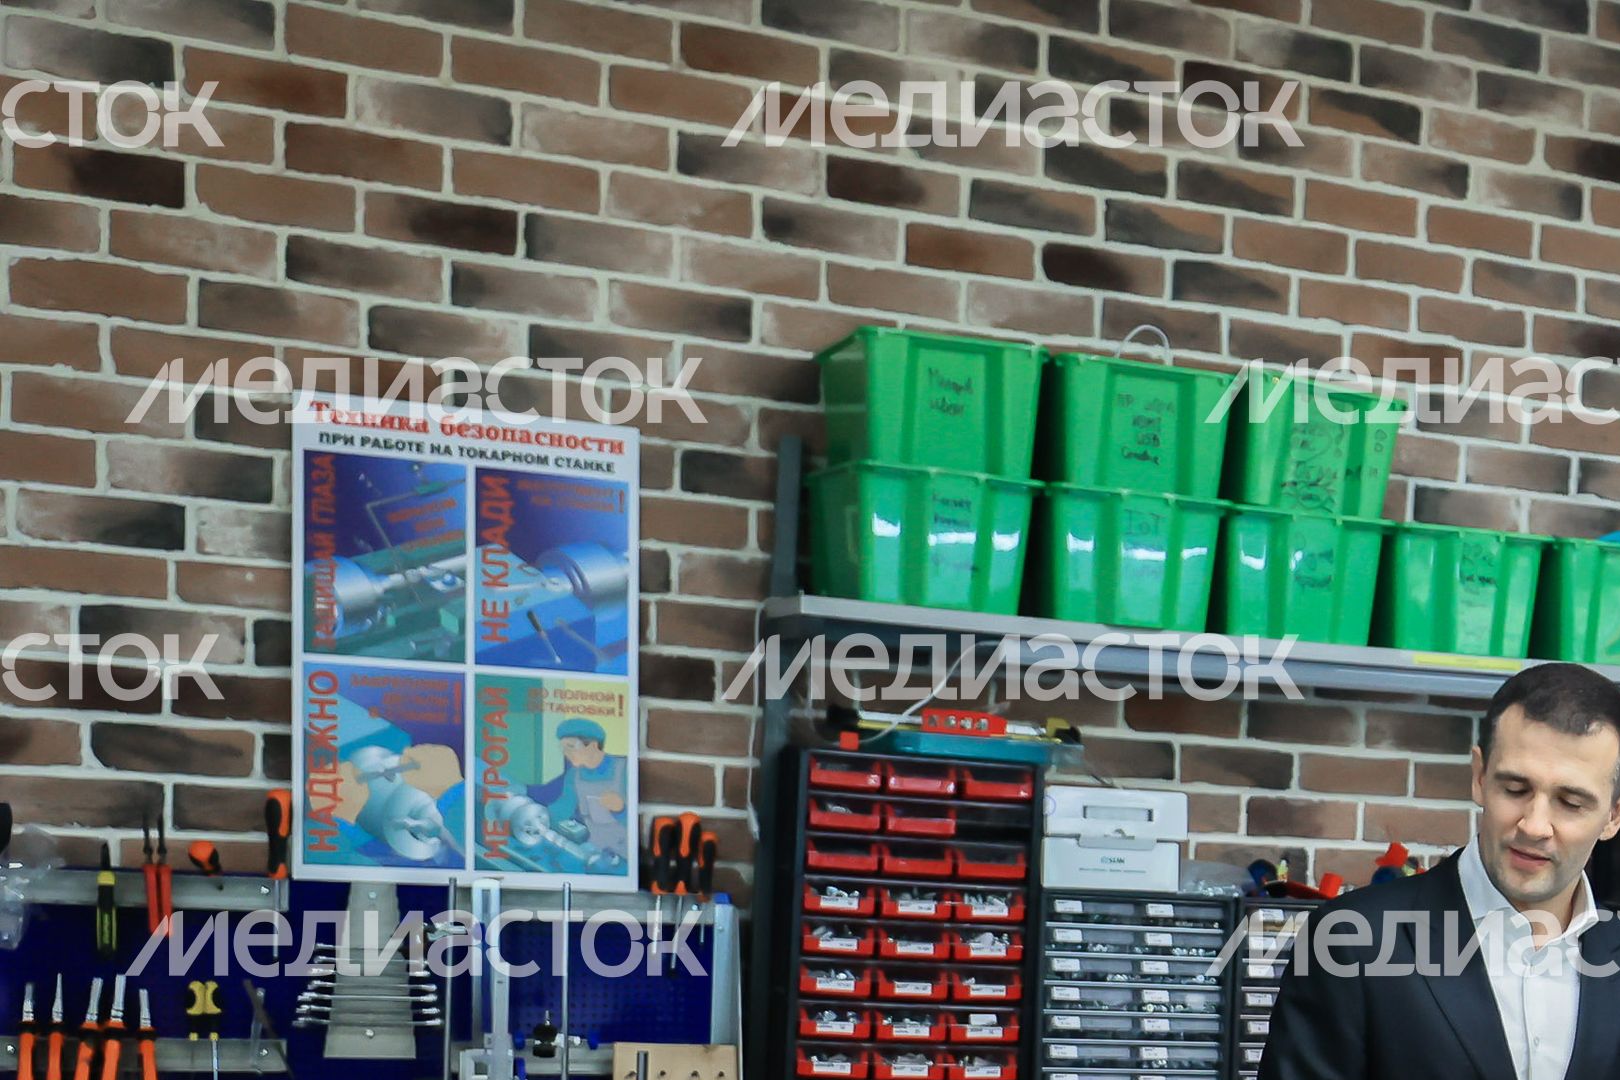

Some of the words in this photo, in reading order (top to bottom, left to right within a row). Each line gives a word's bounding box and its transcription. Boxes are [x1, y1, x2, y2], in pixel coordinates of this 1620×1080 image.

[310, 399, 430, 434] Техника
[441, 415, 625, 455] безопасности
[319, 431, 354, 447] ПРИ
[360, 435, 424, 454] РАБОТЕ
[430, 442, 453, 457] НА
[459, 446, 550, 467] ТОКАРНОМ
[555, 457, 616, 474] СТАНКЕ
[481, 475, 515, 587] КЛАДИ
[481, 598, 509, 643] НЕ
[308, 670, 344, 852] НАДЕЖНО
[479, 686, 510, 804] ТРОГАЙ
[484, 820, 510, 859] НЕ
